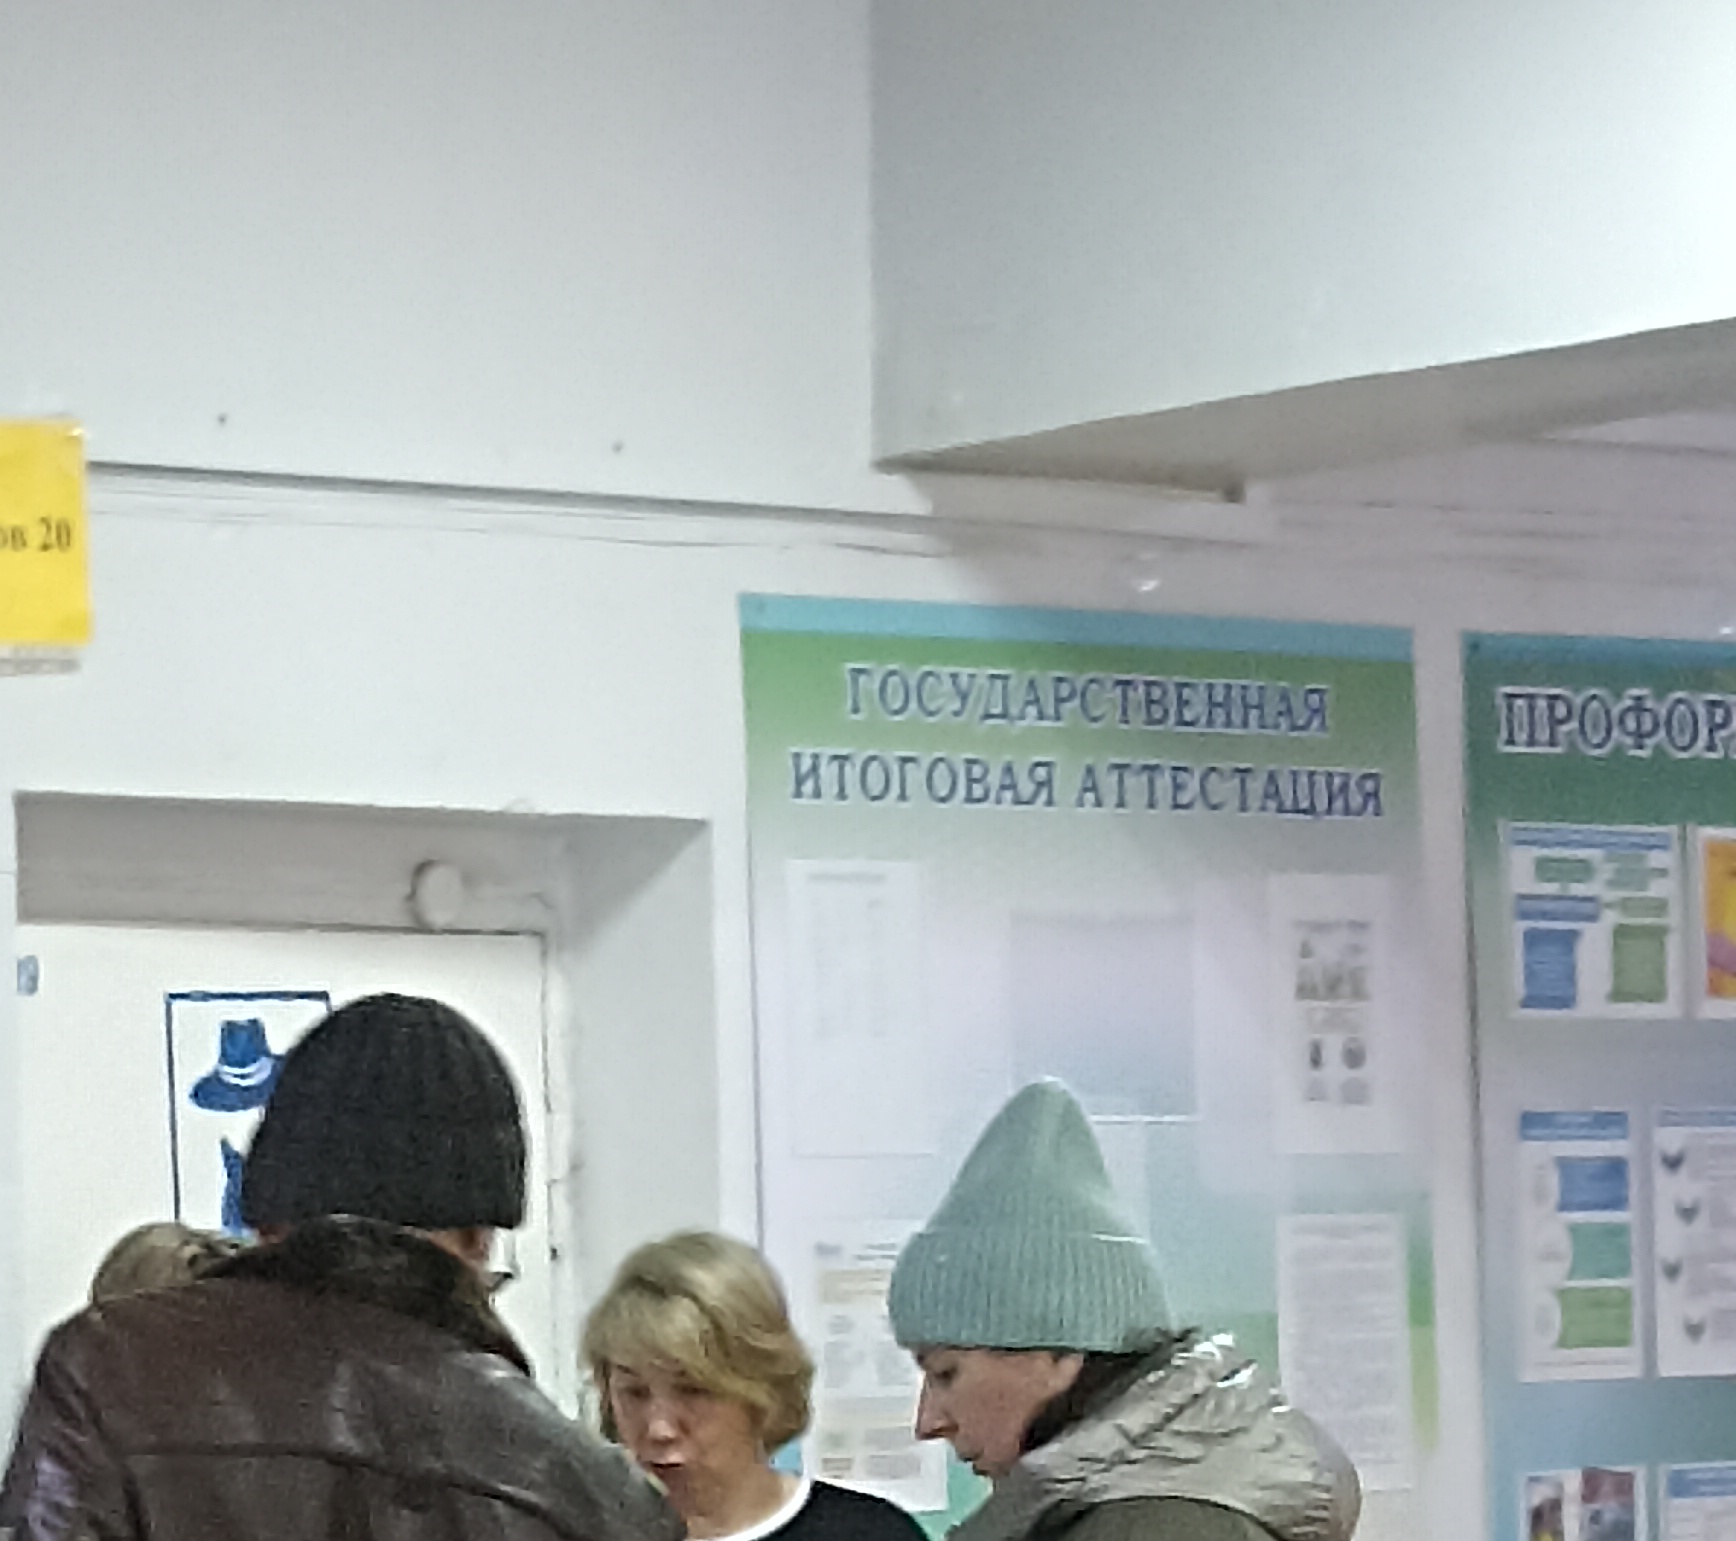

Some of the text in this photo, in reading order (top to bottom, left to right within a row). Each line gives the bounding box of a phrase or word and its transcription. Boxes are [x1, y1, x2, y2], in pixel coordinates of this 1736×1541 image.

[38, 515, 72, 553] 20
[846, 666, 1331, 734] ГОСУДАРСТВЕННАЯ
[1503, 692, 1736, 754] ПРОФОР
[789, 751, 1385, 820] ИТОГОВАЯ АТТЕСТАЦИЯ
